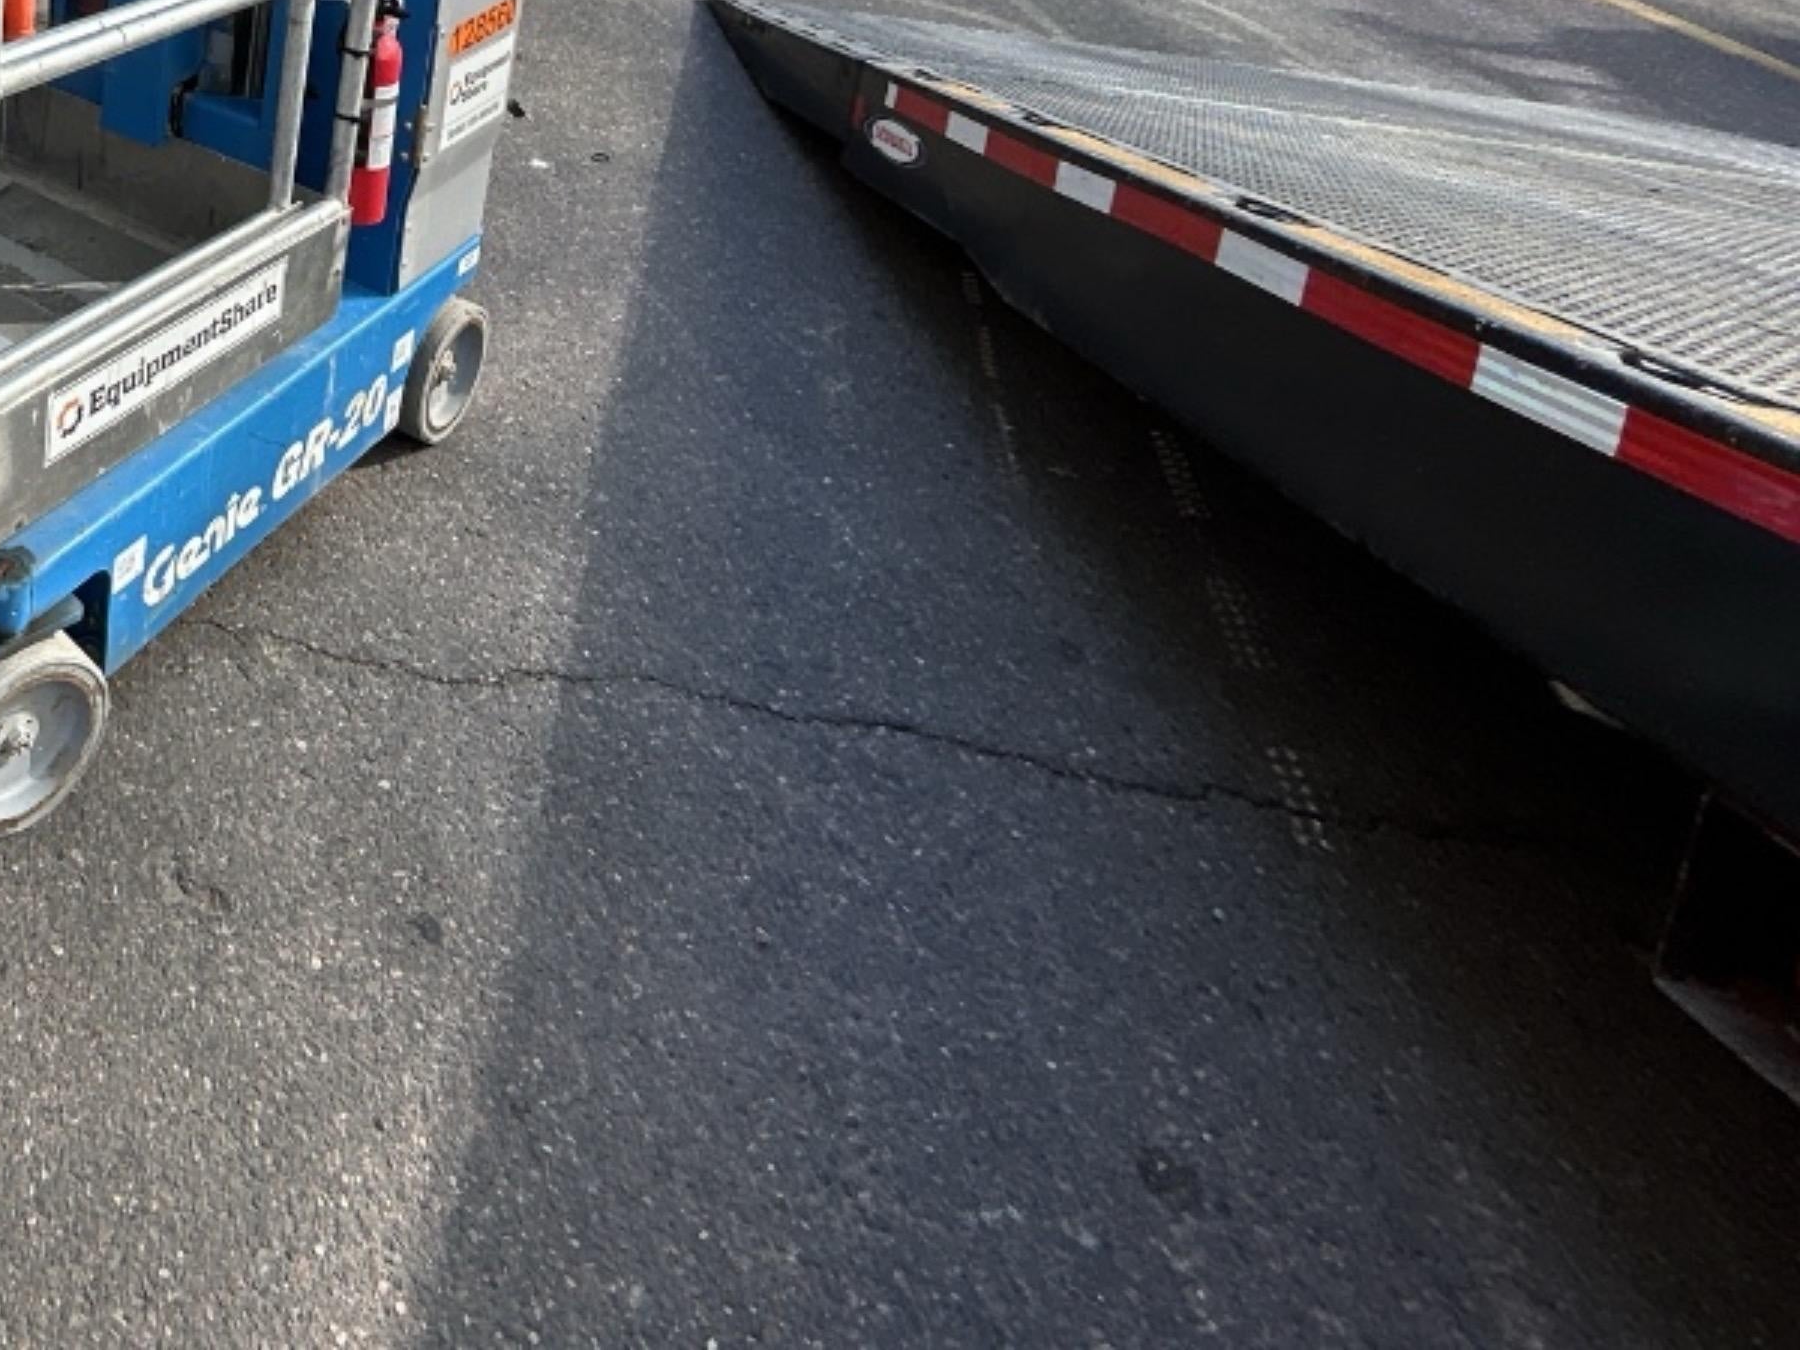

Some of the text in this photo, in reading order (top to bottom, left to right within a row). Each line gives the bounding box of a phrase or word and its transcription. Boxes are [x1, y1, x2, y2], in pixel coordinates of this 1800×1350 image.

[89, 281, 278, 417] EquipmentShare
[143, 373, 389, 608] Genie GR-20
